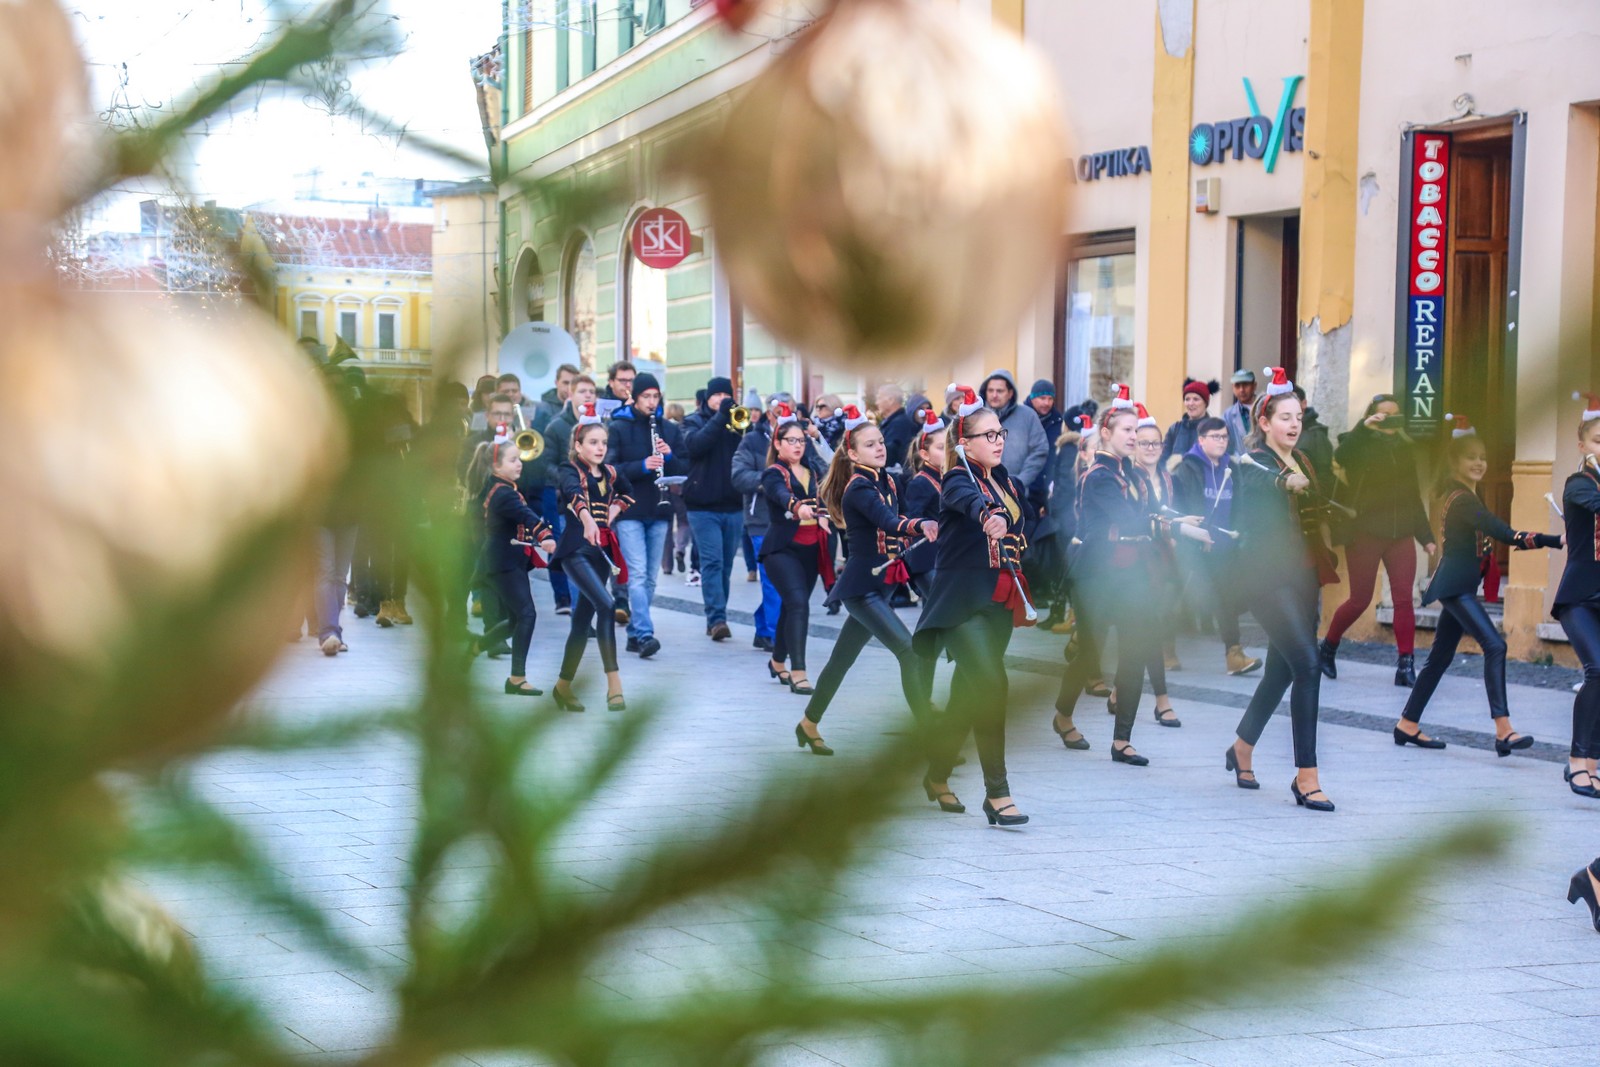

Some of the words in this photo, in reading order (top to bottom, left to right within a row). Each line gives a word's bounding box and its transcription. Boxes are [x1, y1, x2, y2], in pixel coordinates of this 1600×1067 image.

[1077, 145, 1152, 182] OPTIKA
[1189, 76, 1305, 174] OPTOVIS
[1415, 139, 1445, 293] TOBACCO
[1412, 299, 1437, 418] REFAN
